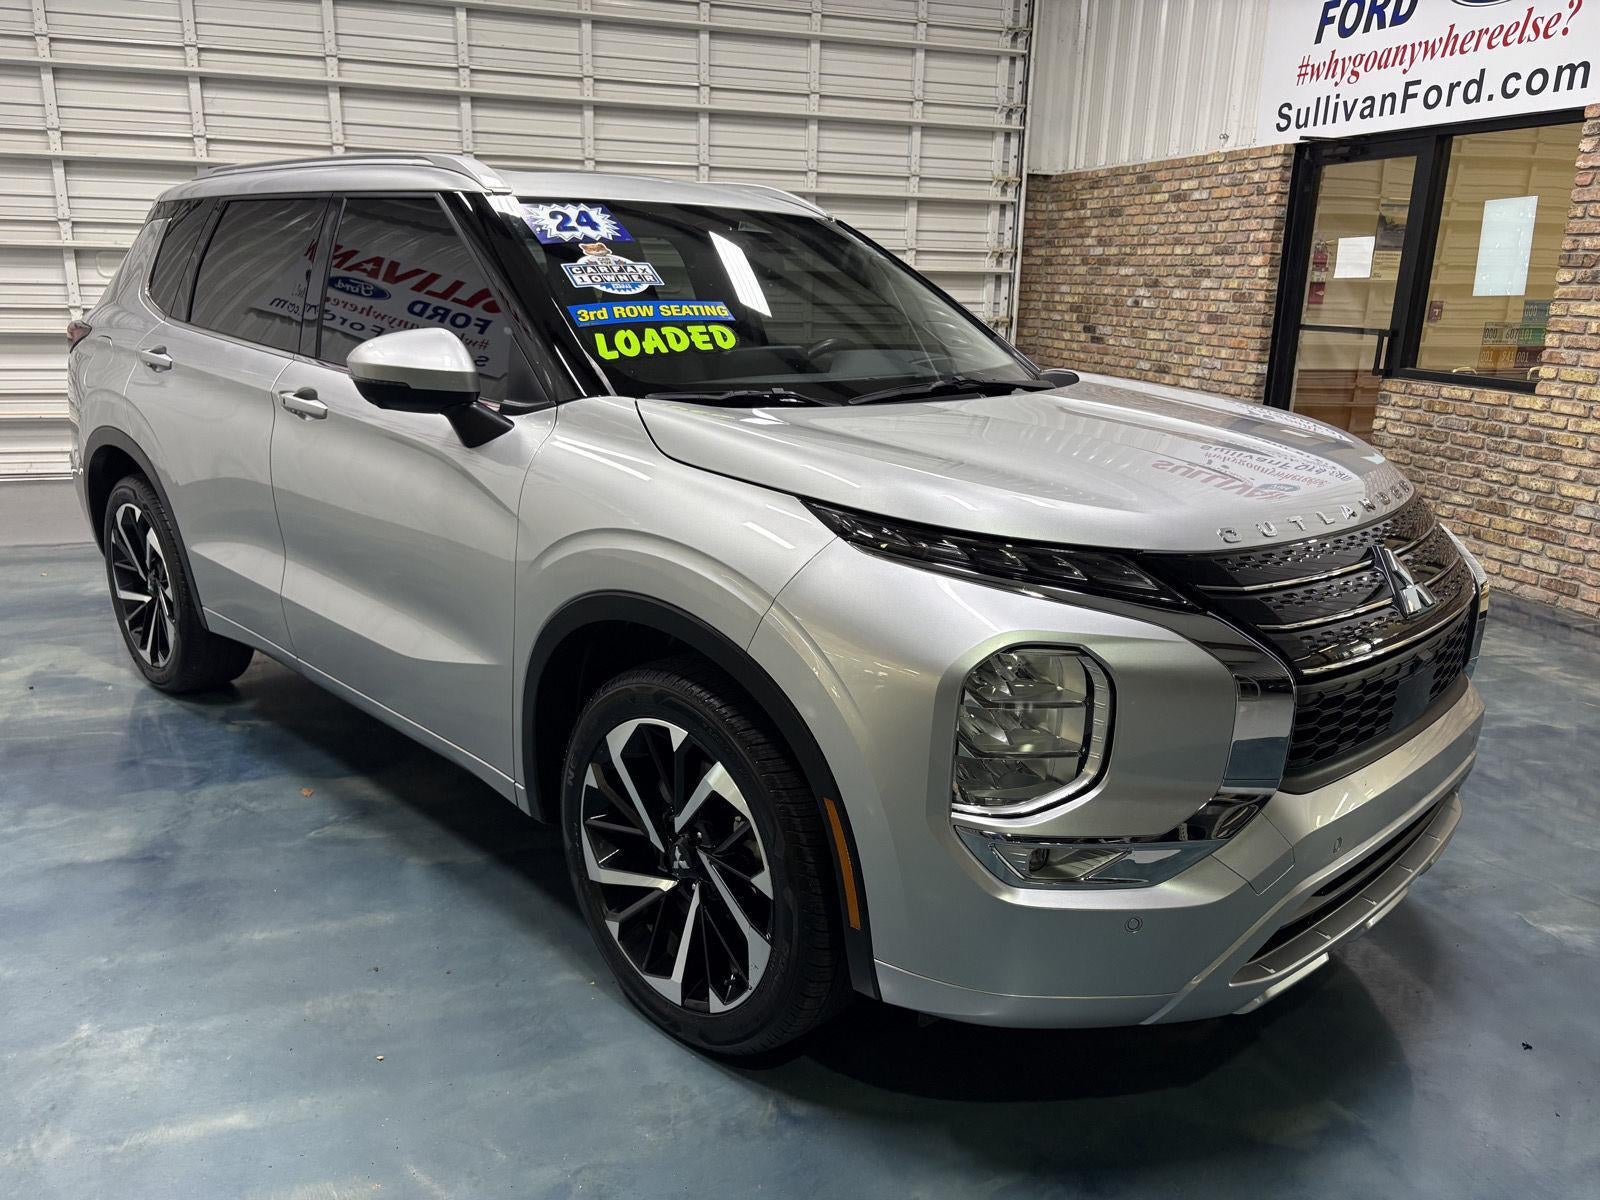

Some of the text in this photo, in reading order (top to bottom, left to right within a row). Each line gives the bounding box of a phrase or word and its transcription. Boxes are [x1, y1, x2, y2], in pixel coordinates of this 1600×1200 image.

[1296, 0, 1583, 87] #whygoanywhereelse?
[1275, 60, 1591, 132] SullivanFord.com
[548, 209, 602, 233] 24
[571, 265, 648, 275] CARFAX
[590, 274, 656, 284] OWNER
[577, 304, 729, 322] 3rd ROW SEATING
[594, 324, 737, 361] LOADED
[1216, 479, 1411, 543] OUTLANDER
